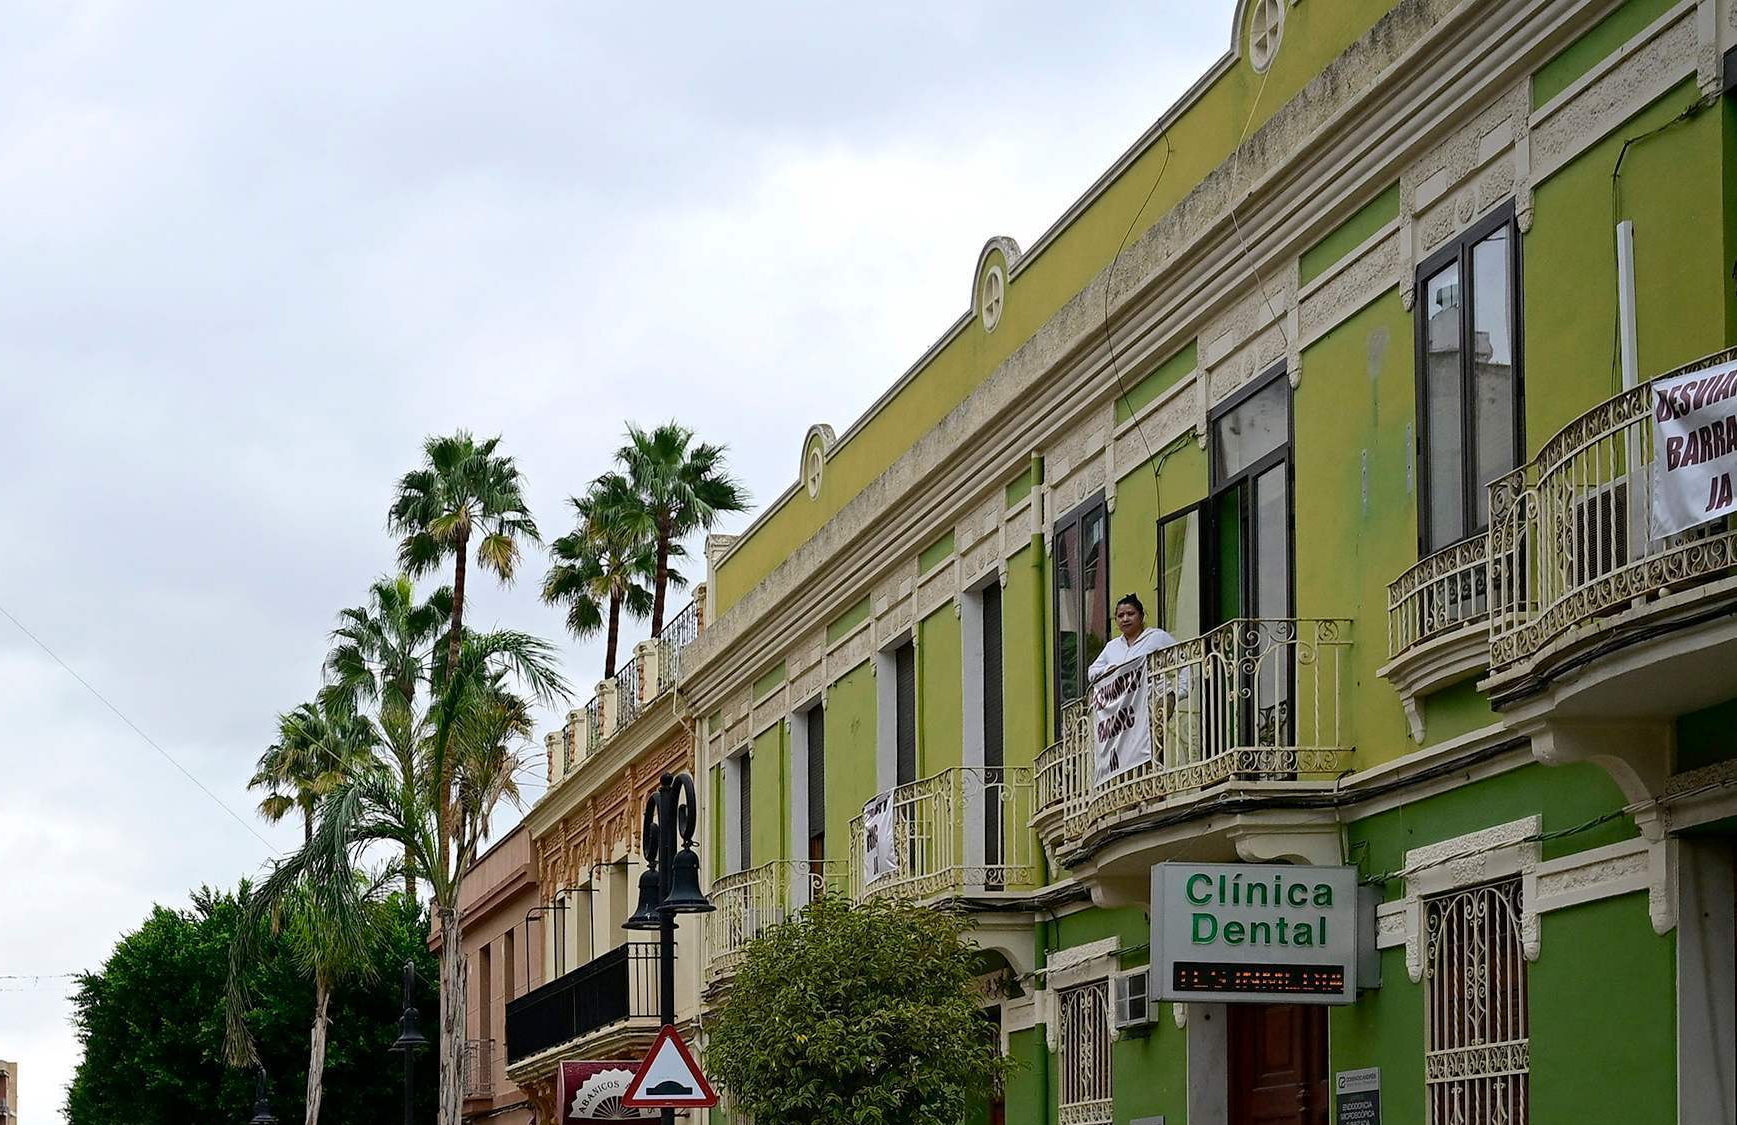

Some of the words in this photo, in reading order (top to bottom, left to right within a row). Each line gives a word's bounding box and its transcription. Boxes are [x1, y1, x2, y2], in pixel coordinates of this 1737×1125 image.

[1705, 472, 1733, 513] JA
[1185, 873, 1334, 906] Clínica
[1191, 912, 1328, 946] Dental
[578, 1080, 620, 1114] ABANICOS
